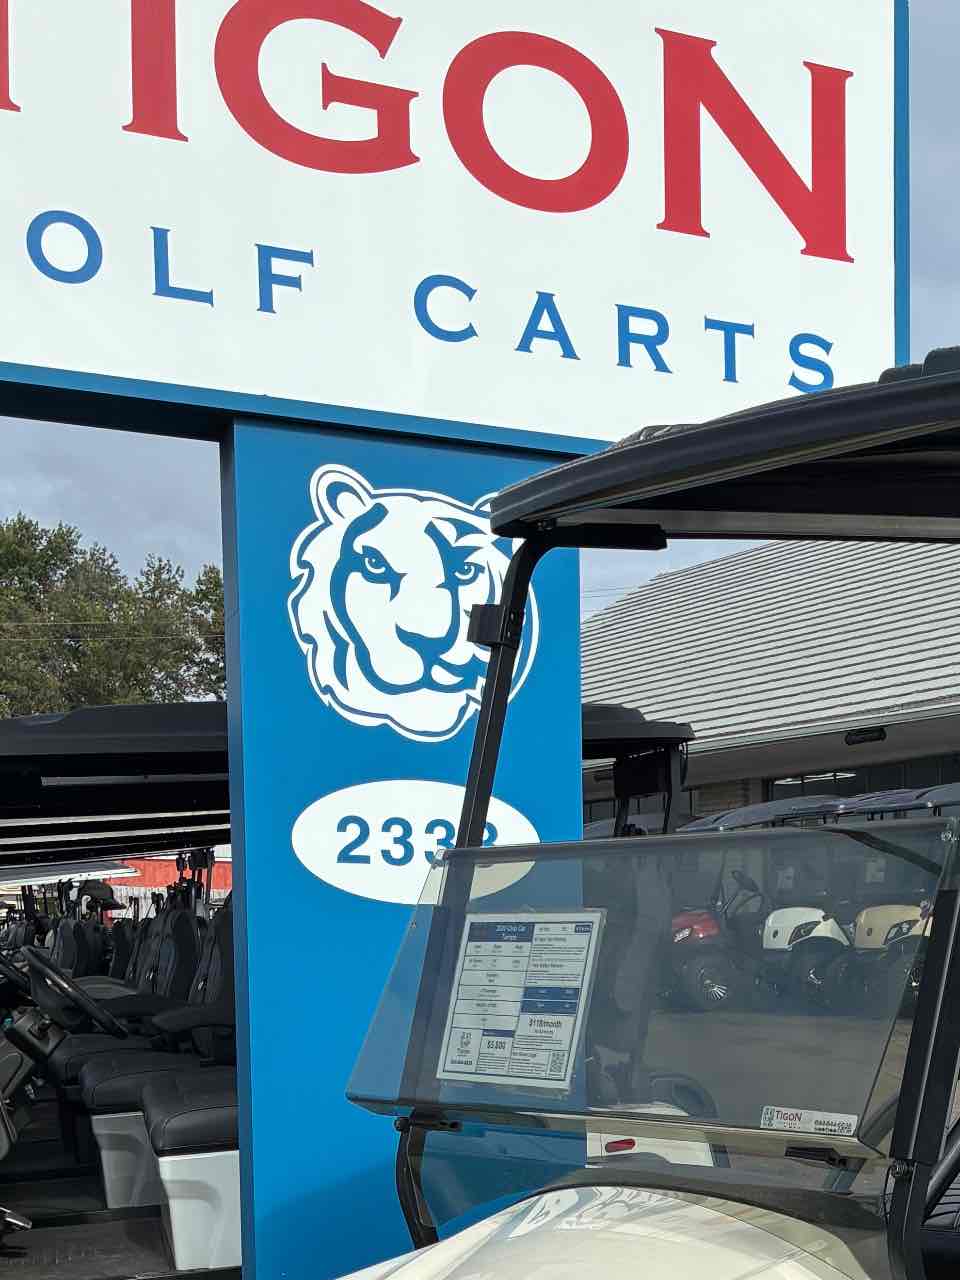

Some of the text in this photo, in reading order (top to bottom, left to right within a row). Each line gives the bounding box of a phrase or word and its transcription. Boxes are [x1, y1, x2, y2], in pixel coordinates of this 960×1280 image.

[0, 0, 855, 263] IGON
[26, 210, 835, 393] OLF CARTS
